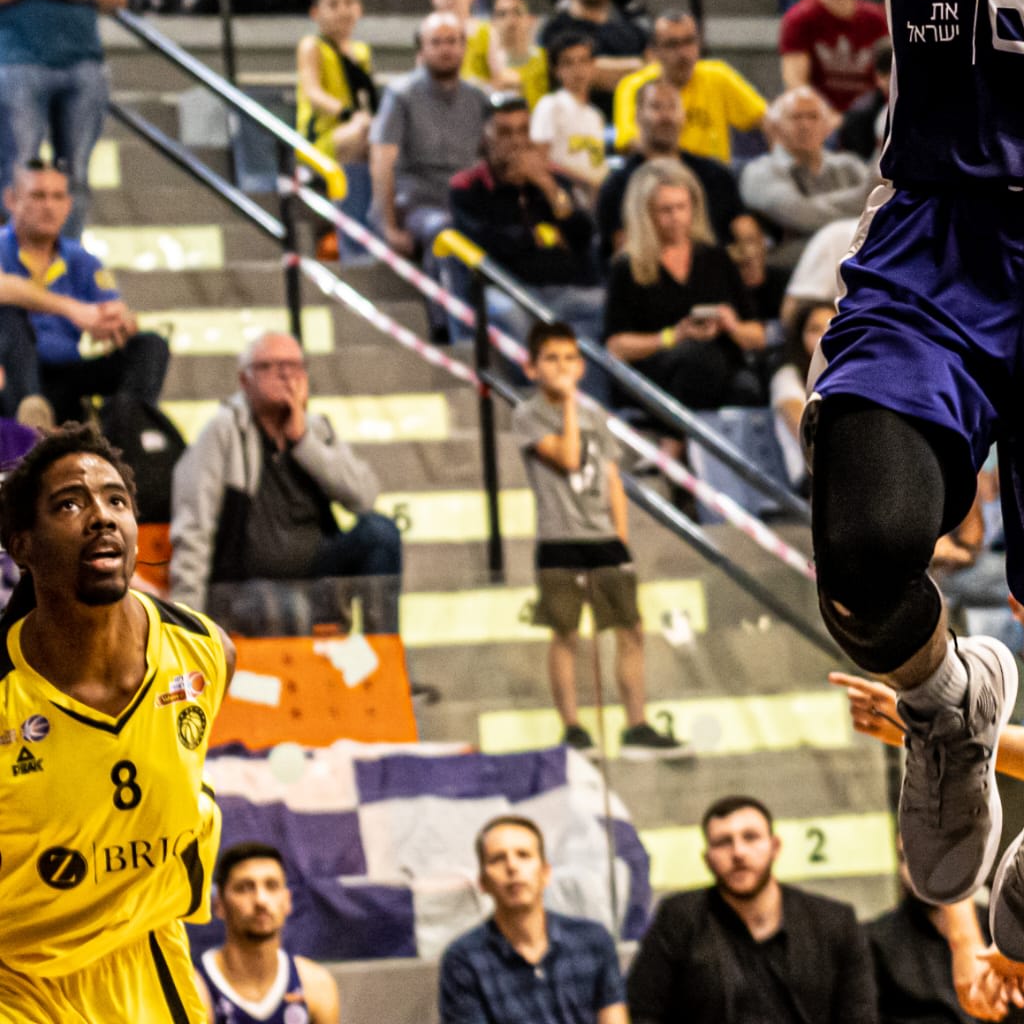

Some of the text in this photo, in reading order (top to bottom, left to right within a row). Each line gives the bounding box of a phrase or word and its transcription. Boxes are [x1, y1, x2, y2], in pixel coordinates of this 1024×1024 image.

[930, 2, 959, 20] את
[907, 21, 960, 43] ישראל
[111, 760, 142, 810] 8
[805, 826, 828, 863] 2
